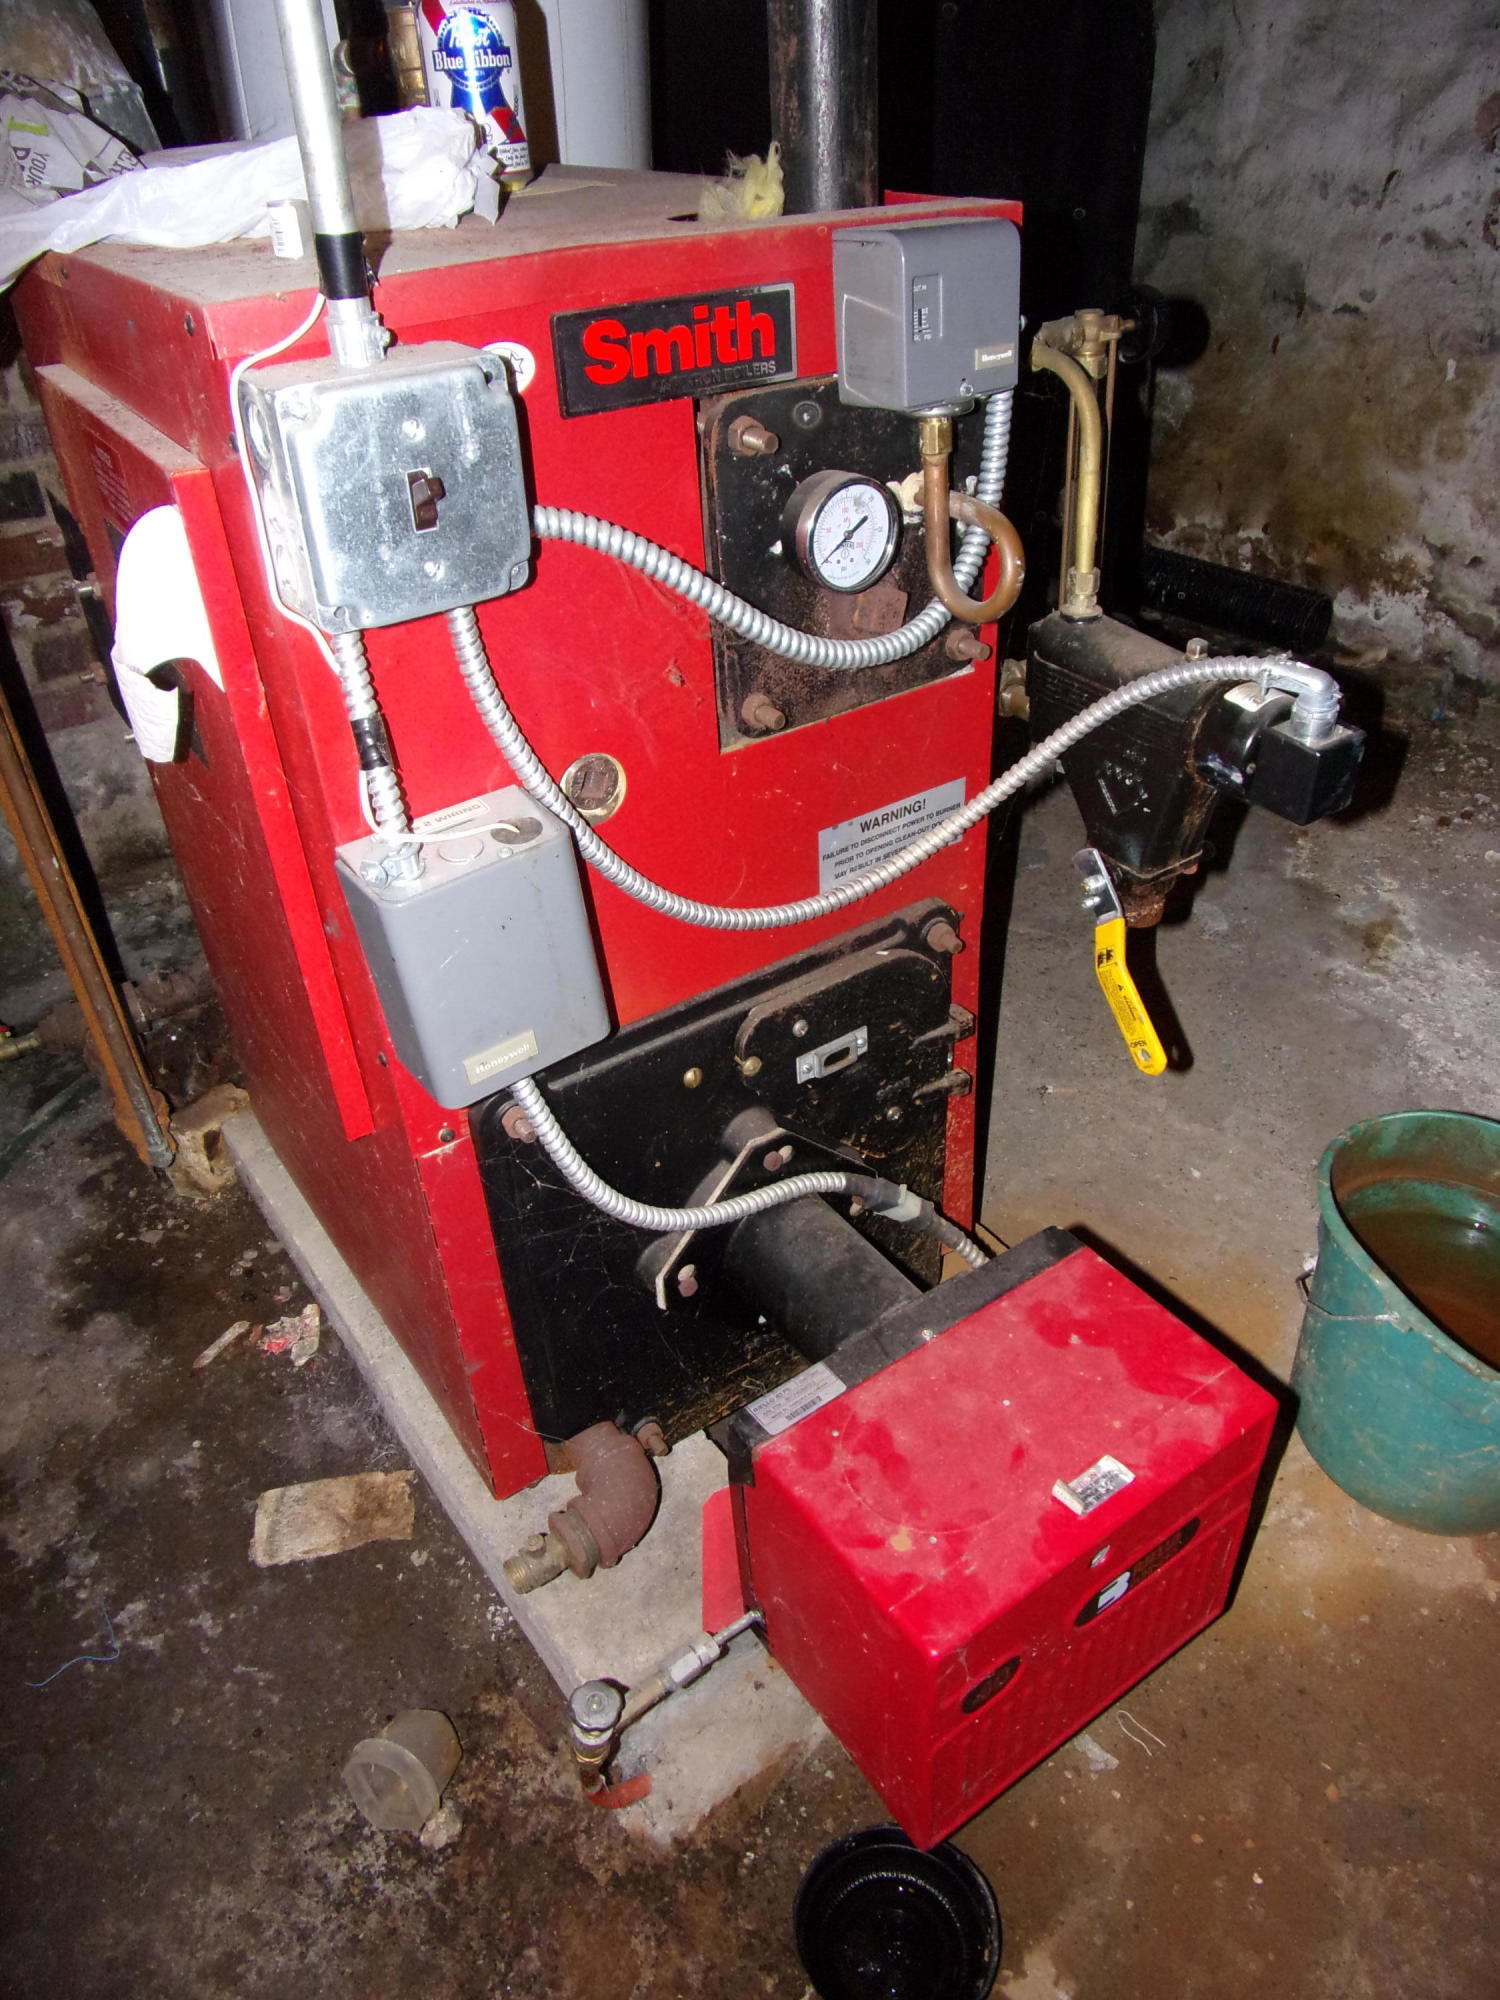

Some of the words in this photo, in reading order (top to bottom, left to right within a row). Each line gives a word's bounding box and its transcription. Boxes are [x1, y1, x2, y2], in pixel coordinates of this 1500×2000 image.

[433, 51, 464, 70] Blue
[583, 300, 776, 385] Smith
[822, 846, 849, 861] FAILURE
[850, 842, 860, 851] TO
[860, 826, 901, 847] DISCONNECT
[902, 816, 925, 831] POWER
[926, 813, 935, 822] TO
[935, 803, 961, 817] BURNER
[860, 797, 927, 833] WARNING!
[834, 856, 855, 867] PRIOR
[856, 850, 865, 860] TO
[865, 840, 893, 856] OPENING
[894, 826, 930, 844] CLEAN-OUT
[834, 869, 848, 879] MAY
[850, 860, 874, 873] RESULT
[875, 856, 882, 864] IN
[882, 846, 907, 859] SEVERE
[475, 1043, 530, 1075] Honeywell
[1129, 1039, 1147, 1048] OPEN
